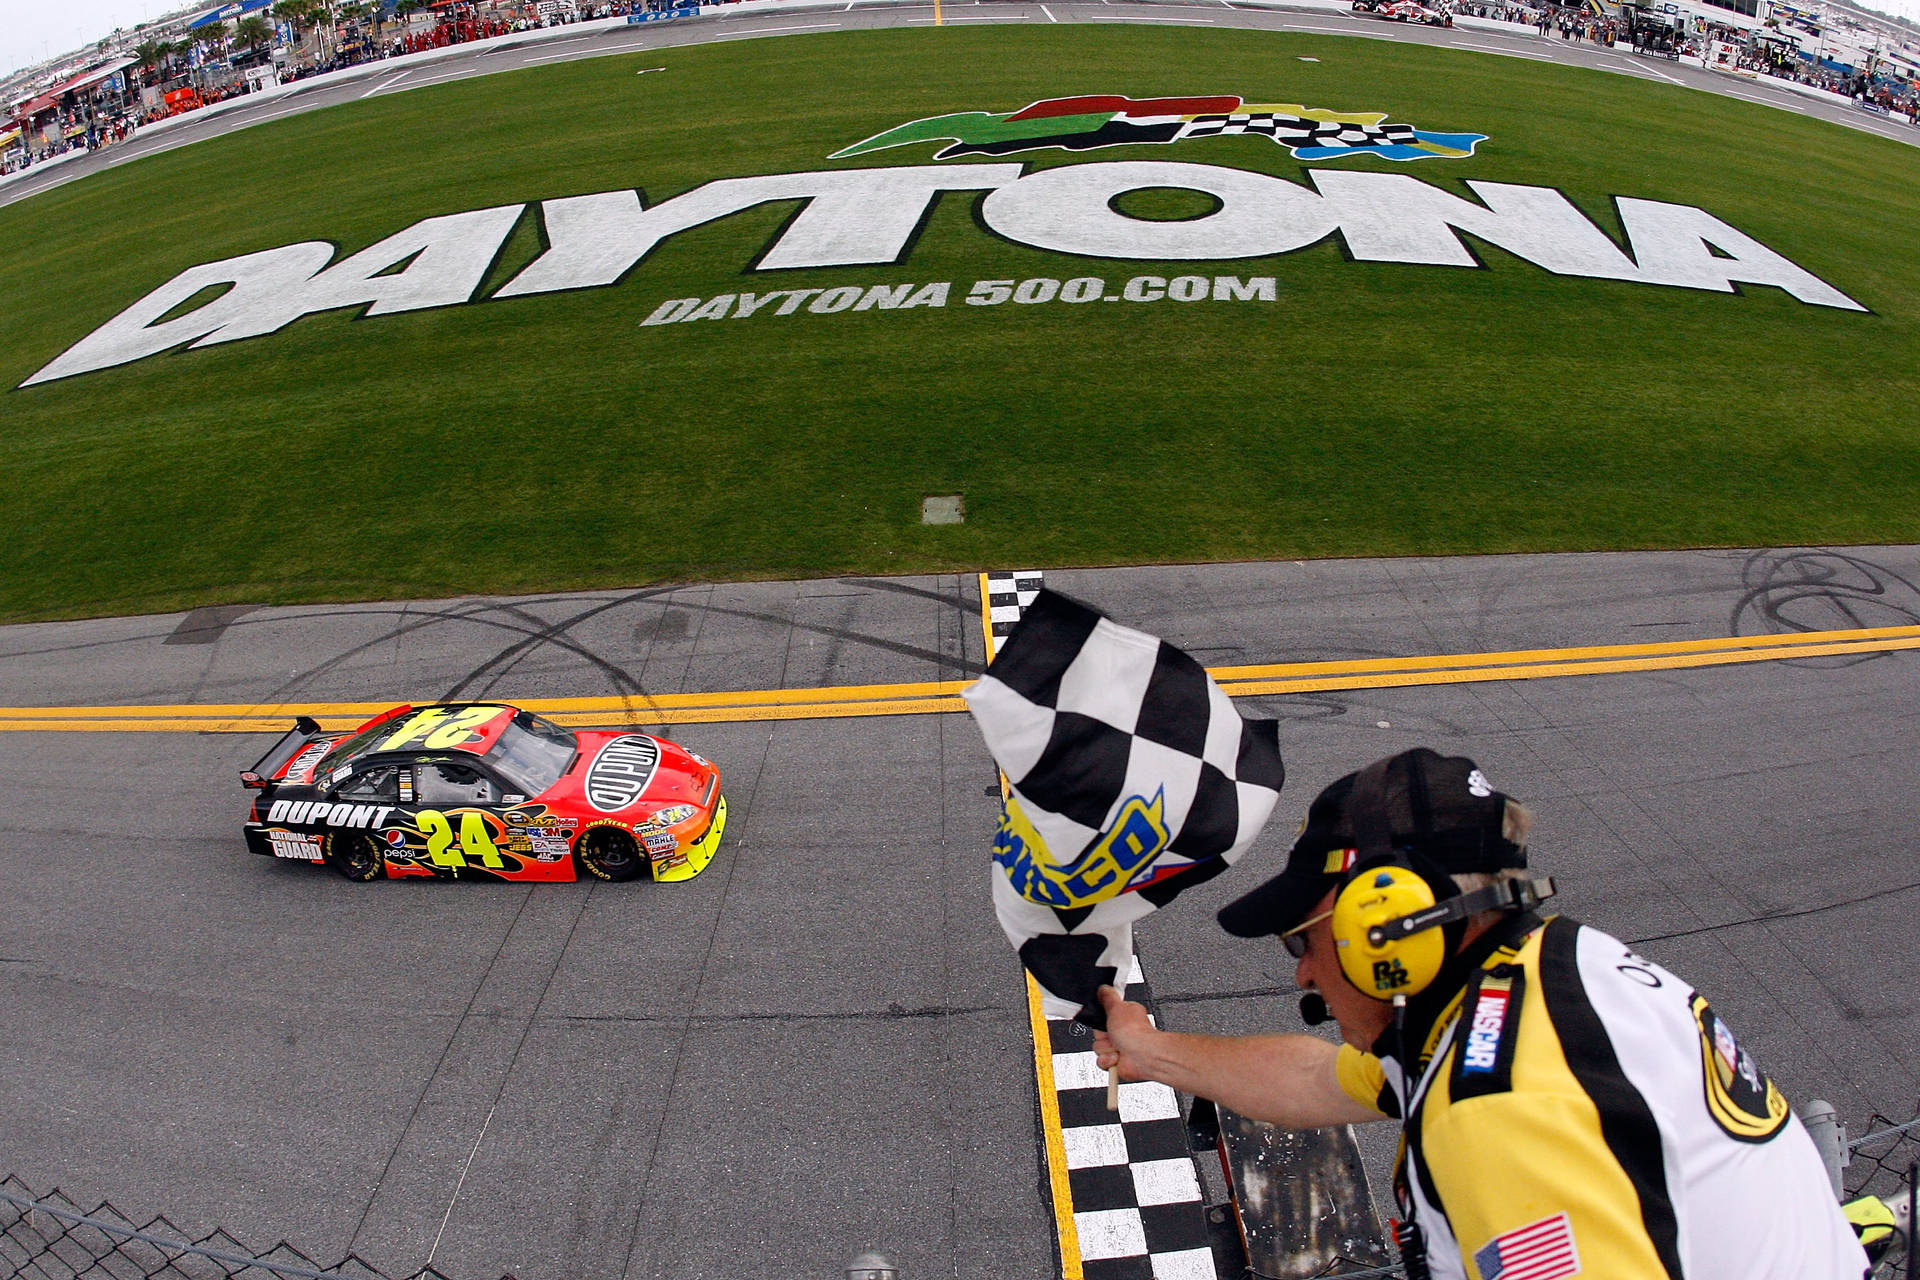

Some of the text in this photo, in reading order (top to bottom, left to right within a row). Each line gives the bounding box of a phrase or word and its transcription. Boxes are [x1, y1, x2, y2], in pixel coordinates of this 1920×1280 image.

[1721, 44, 1733, 53] 3M
[18, 160, 1868, 388] DAYTONA
[640, 276, 1277, 326] DAYTONA 500.COM
[590, 738, 656, 805] DUPONT
[267, 800, 397, 829] DUPONT
[269, 831, 307, 843] NATIONAL
[415, 810, 505, 867] 24
[542, 828, 560, 837] 3M
[646, 834, 675, 847] MAHLE
[273, 842, 324, 860] GUARD
[384, 849, 416, 859] pepsi
[1464, 995, 1507, 1068] NASCAR
